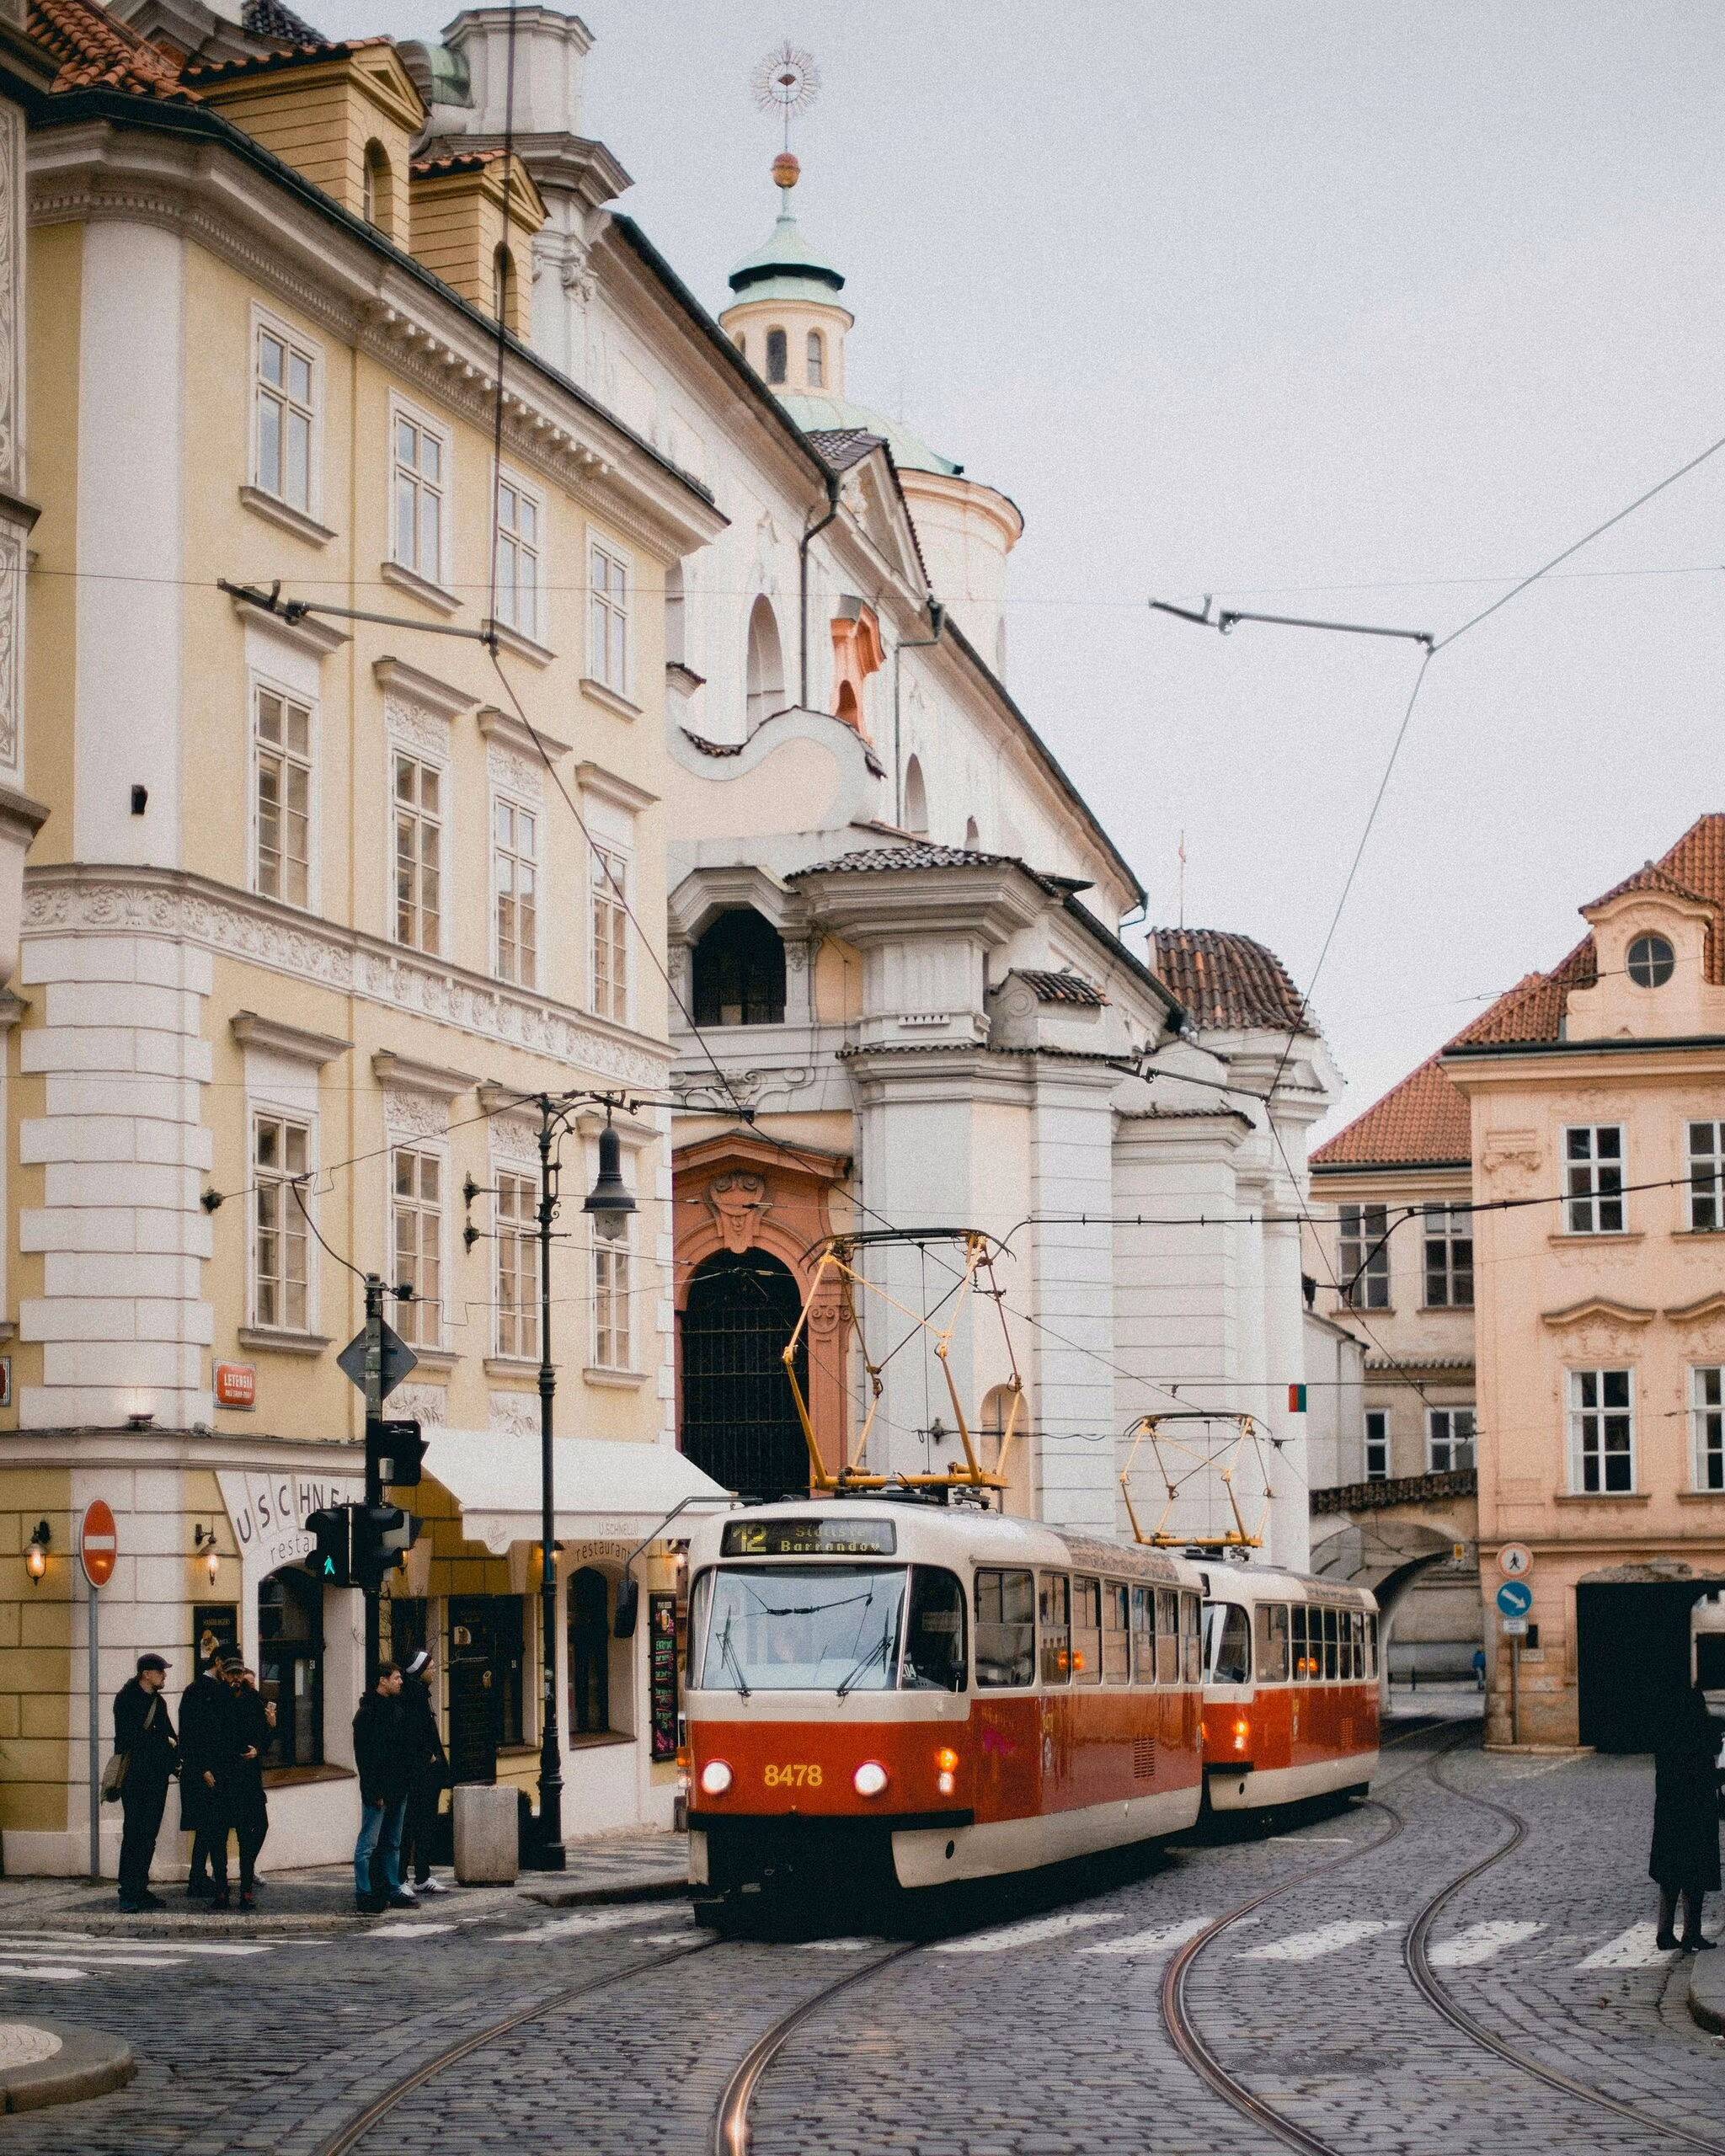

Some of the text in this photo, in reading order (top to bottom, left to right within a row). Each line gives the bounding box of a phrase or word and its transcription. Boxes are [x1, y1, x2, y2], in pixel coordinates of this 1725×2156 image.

[733, 1523, 766, 1552] 12
[780, 1540, 881, 1552] Barrandov
[764, 1764, 823, 1786] 8478
